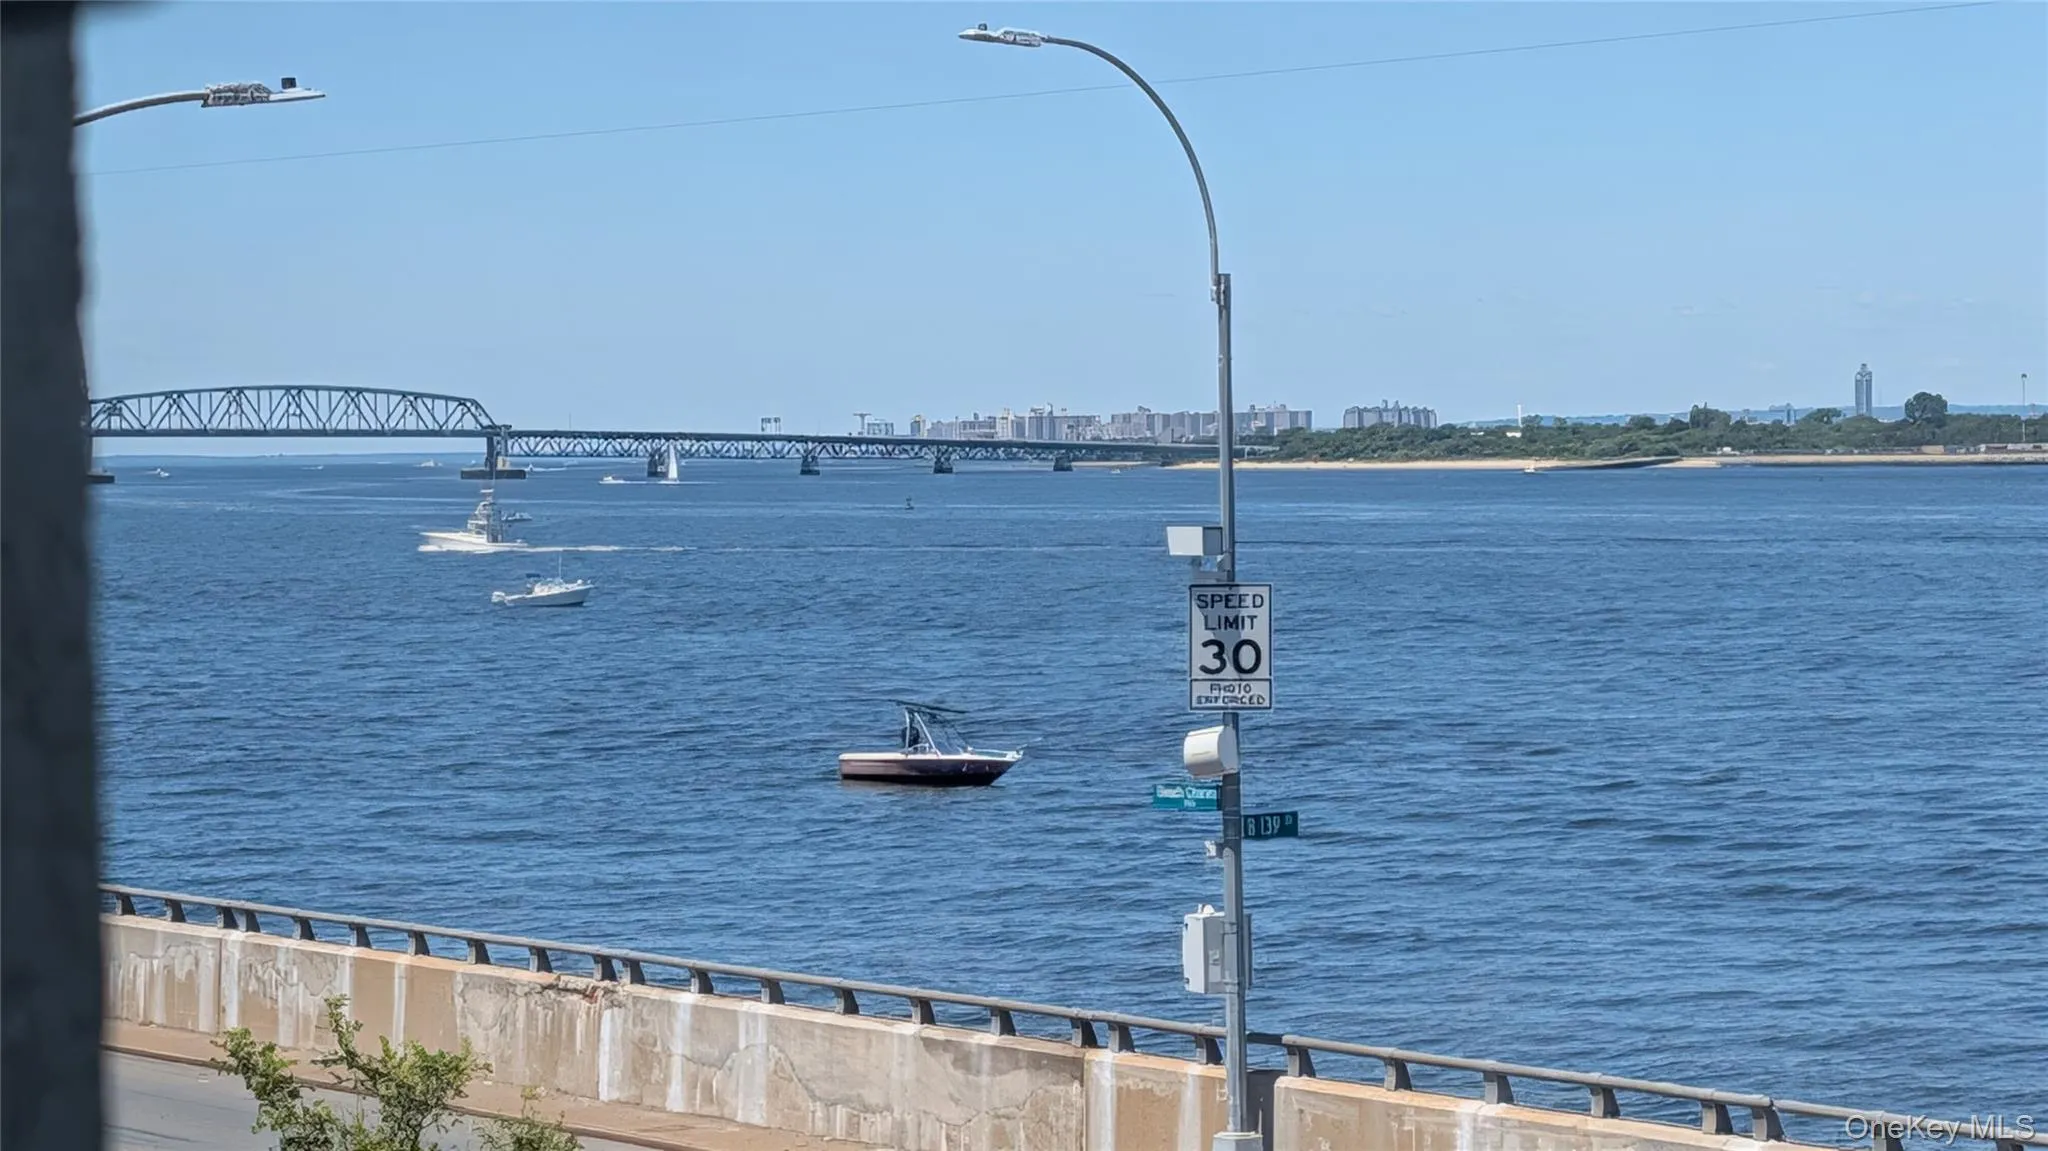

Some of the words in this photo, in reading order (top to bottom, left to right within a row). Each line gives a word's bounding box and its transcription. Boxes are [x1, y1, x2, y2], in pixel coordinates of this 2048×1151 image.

[1196, 593, 1264, 609] SPEED
[1204, 614, 1258, 631] LIMIT
[1199, 639, 1262, 675] 30
[1260, 815, 1281, 836] 139
